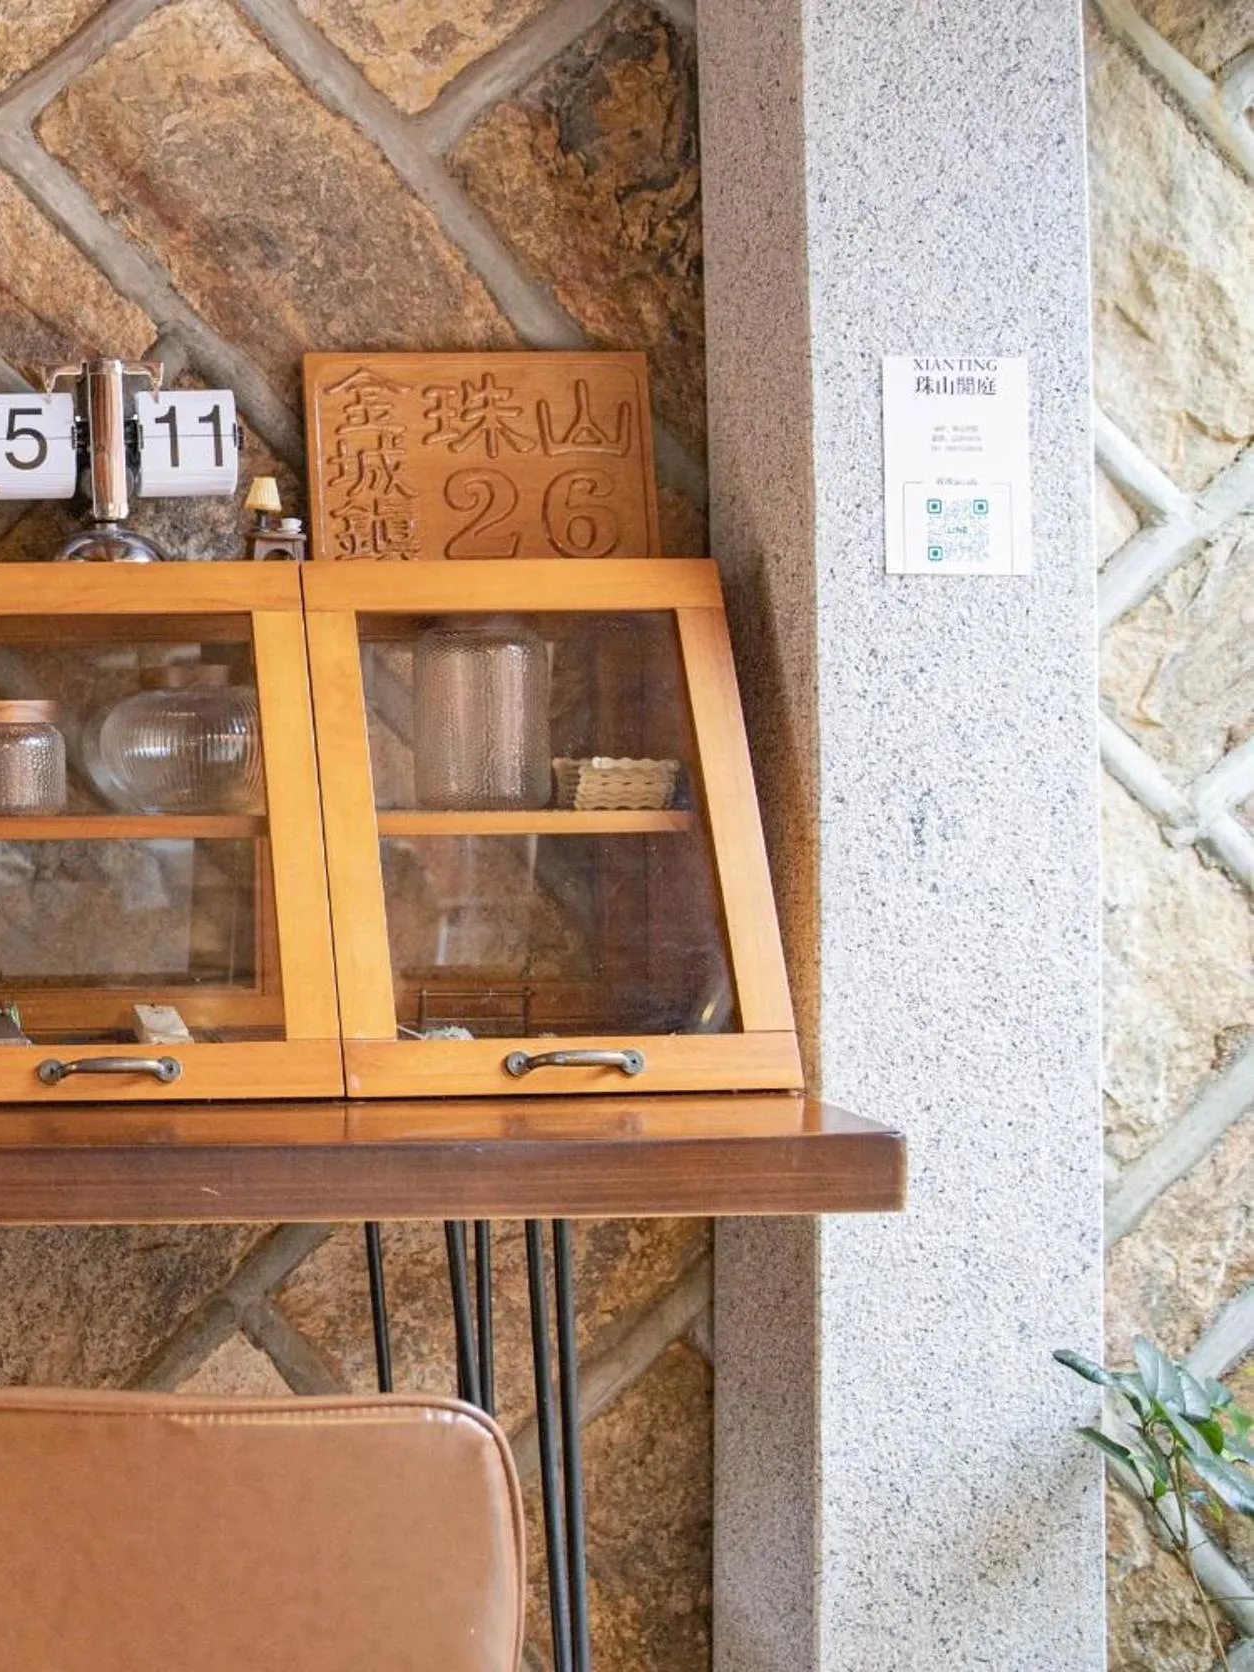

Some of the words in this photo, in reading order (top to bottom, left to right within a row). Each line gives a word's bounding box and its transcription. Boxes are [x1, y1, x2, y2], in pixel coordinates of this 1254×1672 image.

[914, 358, 998, 372] XIANTING
[4, 407, 48, 471] 5
[153, 403, 224, 468] 11
[421, 372, 632, 459] 珠山
[443, 467, 622, 560] 26
